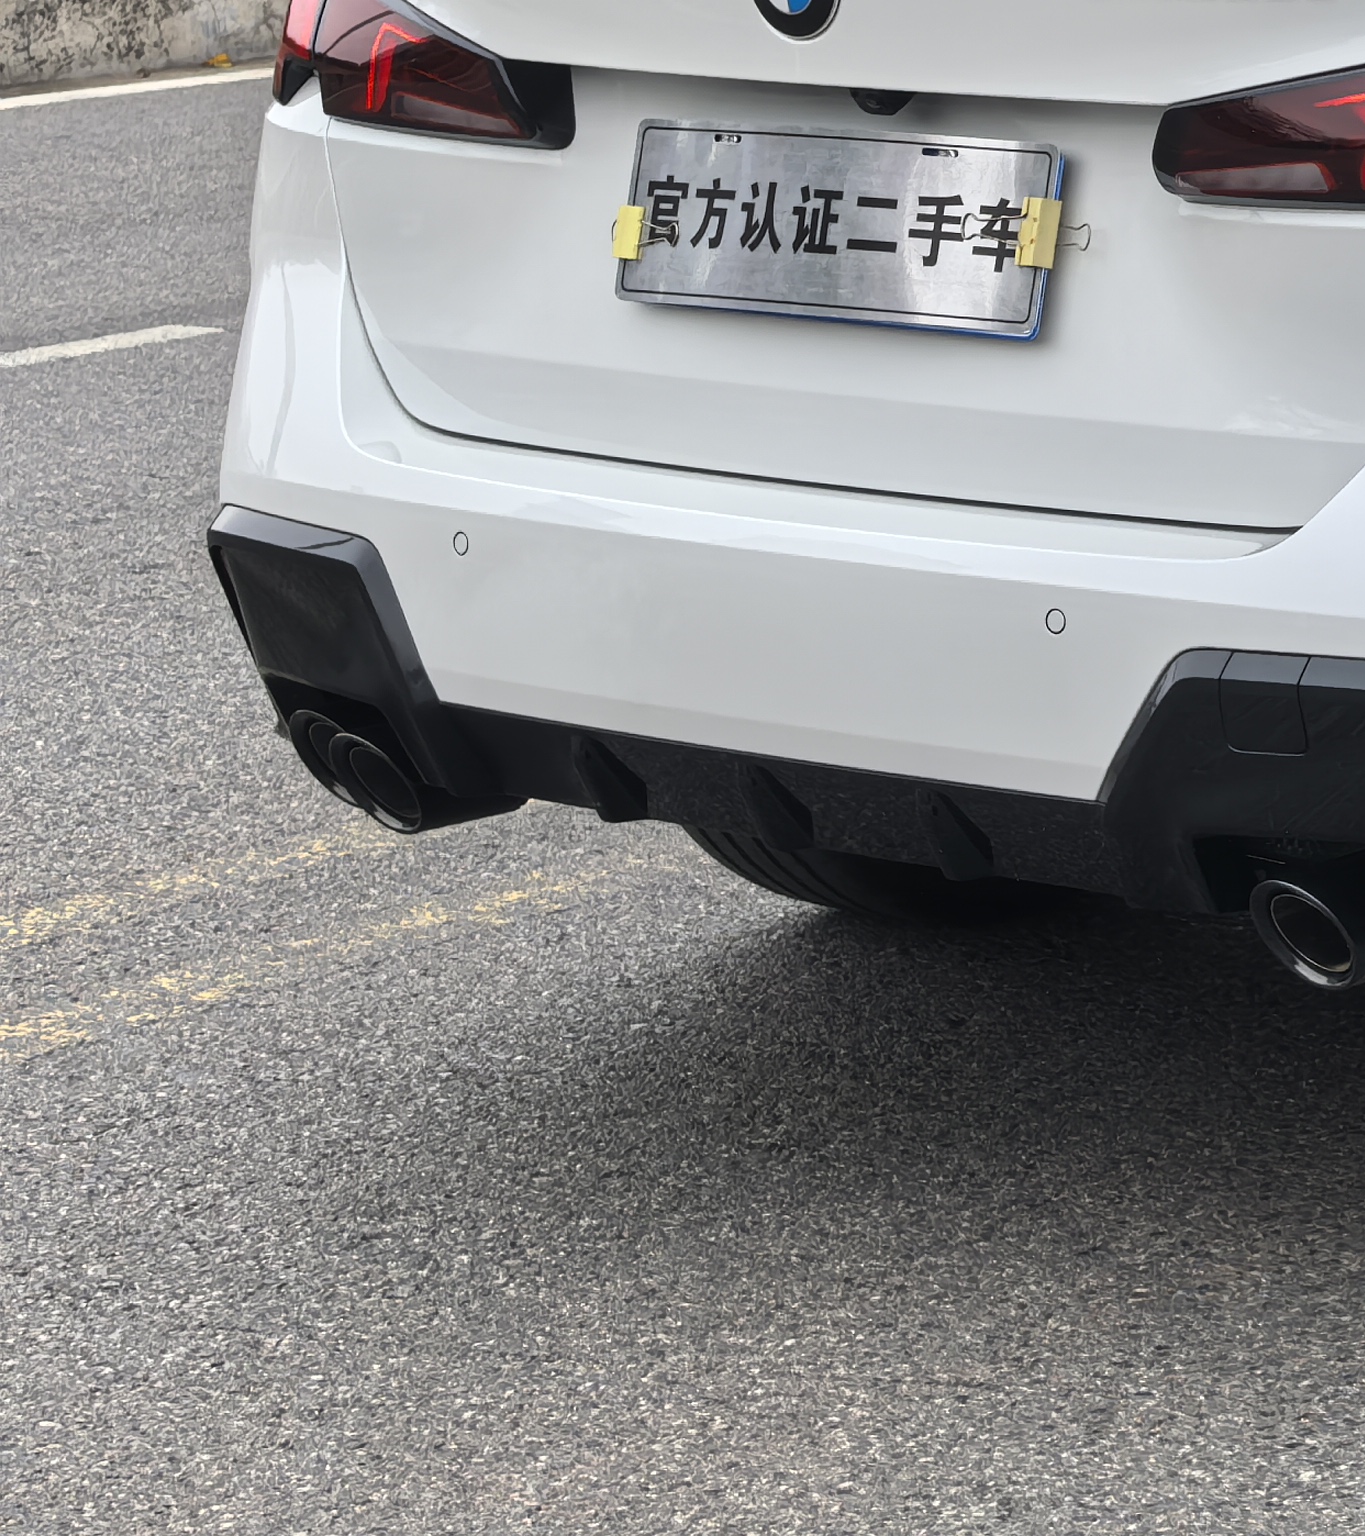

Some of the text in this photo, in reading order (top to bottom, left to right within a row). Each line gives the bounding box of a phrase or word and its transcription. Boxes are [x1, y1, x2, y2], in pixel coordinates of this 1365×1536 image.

[646, 174, 1023, 274] 官方认证二手车
